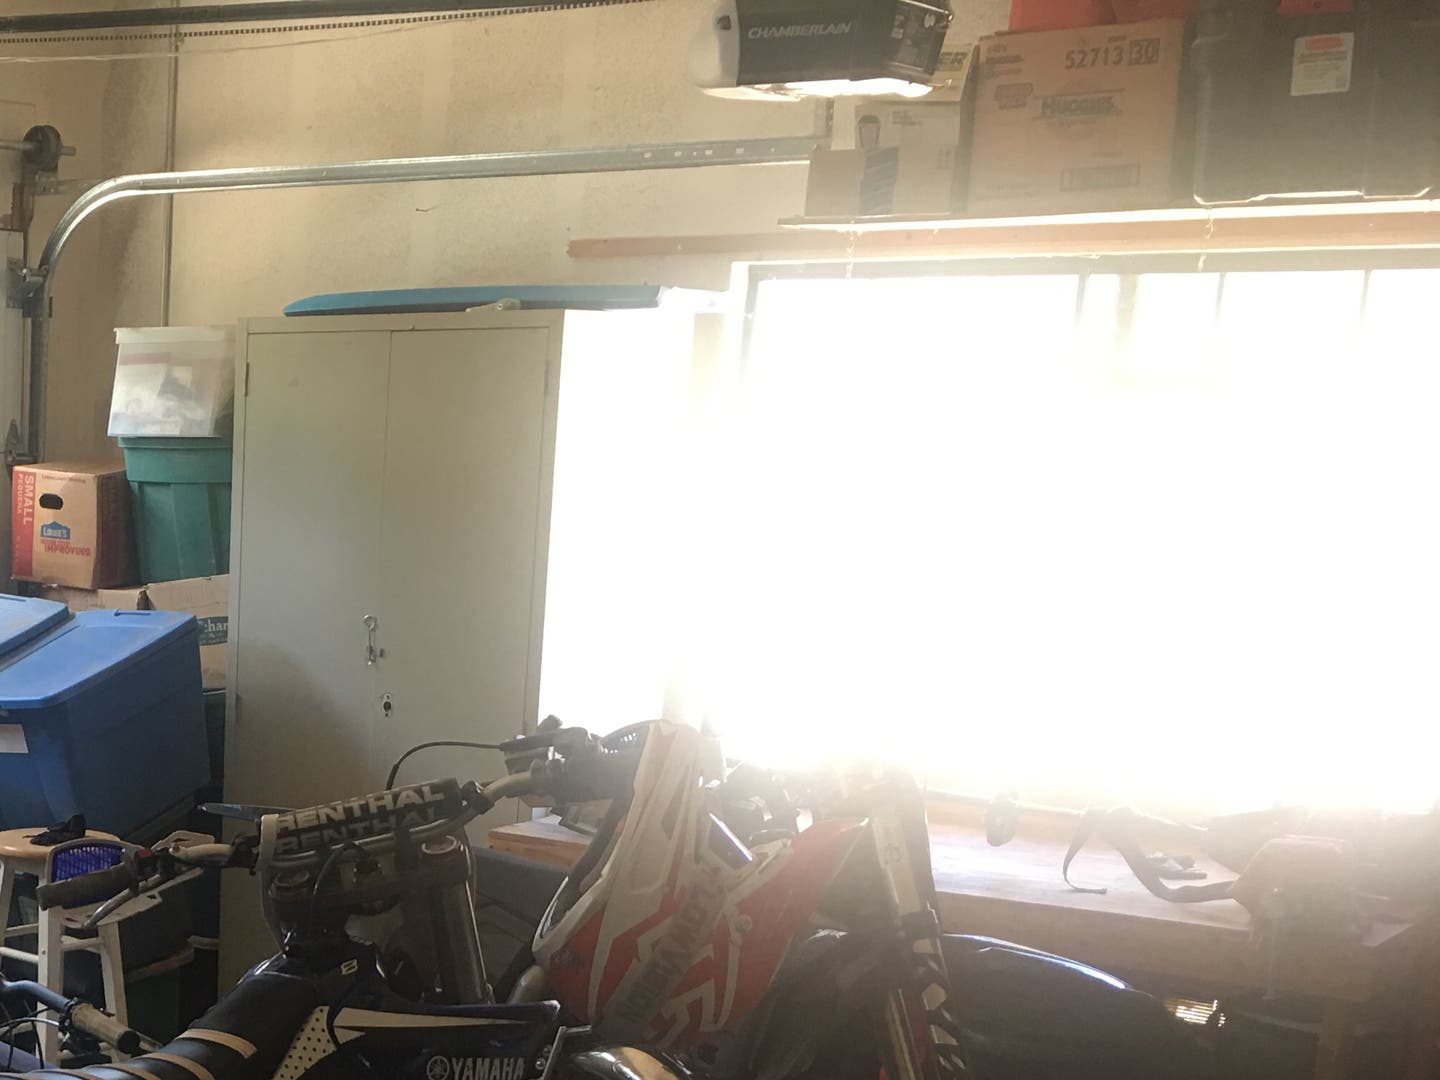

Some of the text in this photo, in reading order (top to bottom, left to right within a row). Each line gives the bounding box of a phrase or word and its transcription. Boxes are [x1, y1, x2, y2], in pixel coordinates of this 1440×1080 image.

[748, 22, 852, 40] CHAMBERLAIN
[1064, 47, 1125, 69] 52713
[23, 474, 35, 526] SMALL
